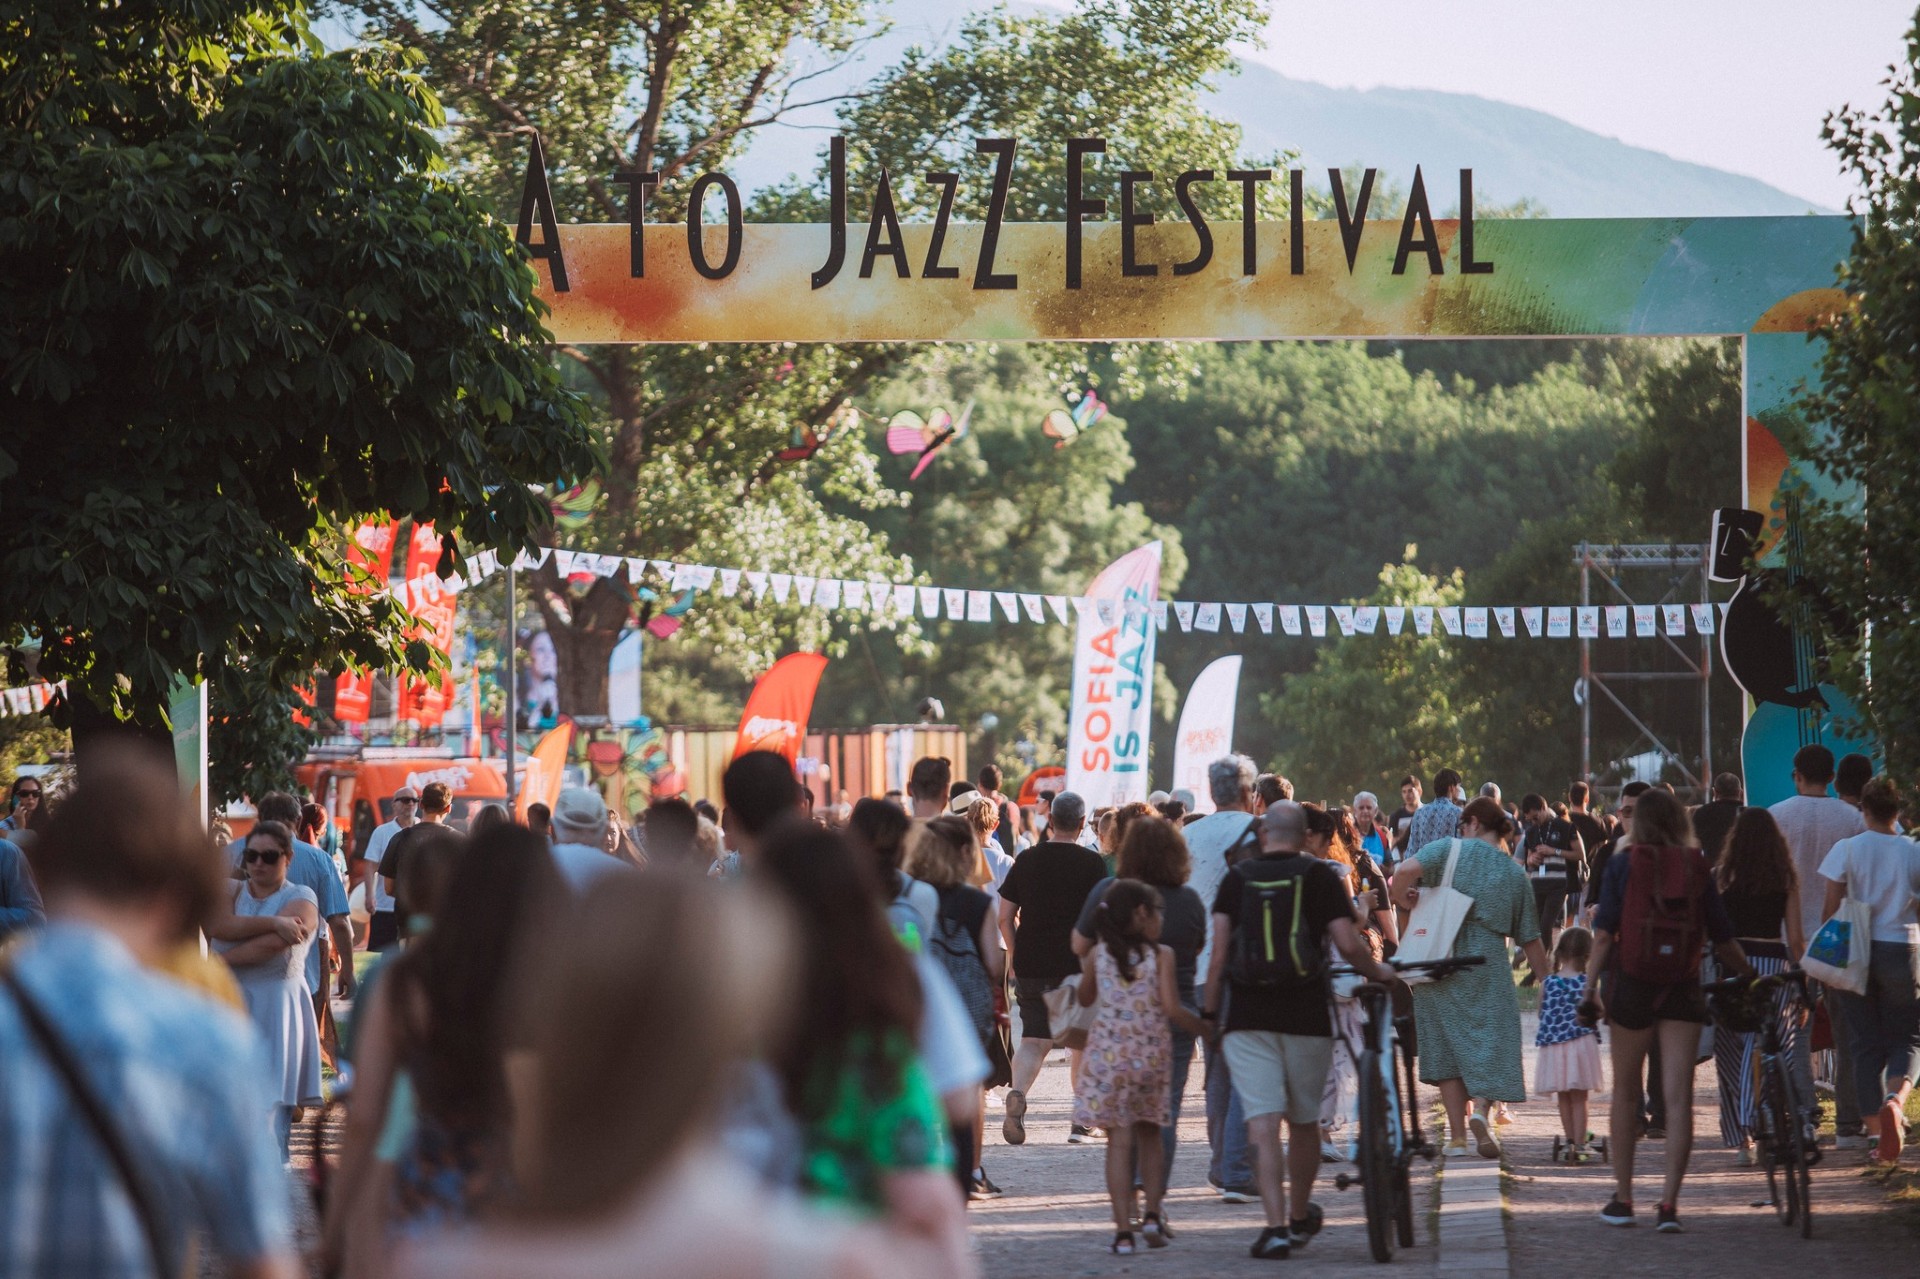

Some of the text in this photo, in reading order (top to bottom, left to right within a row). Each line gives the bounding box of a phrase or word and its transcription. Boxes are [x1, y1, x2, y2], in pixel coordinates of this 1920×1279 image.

[515, 131, 1494, 292] A TO JAZZ FESTIVAL
[1082, 627, 1120, 772] SOFIA
[1116, 582, 1149, 711] JAZZ
[1113, 730, 1141, 773] IS
